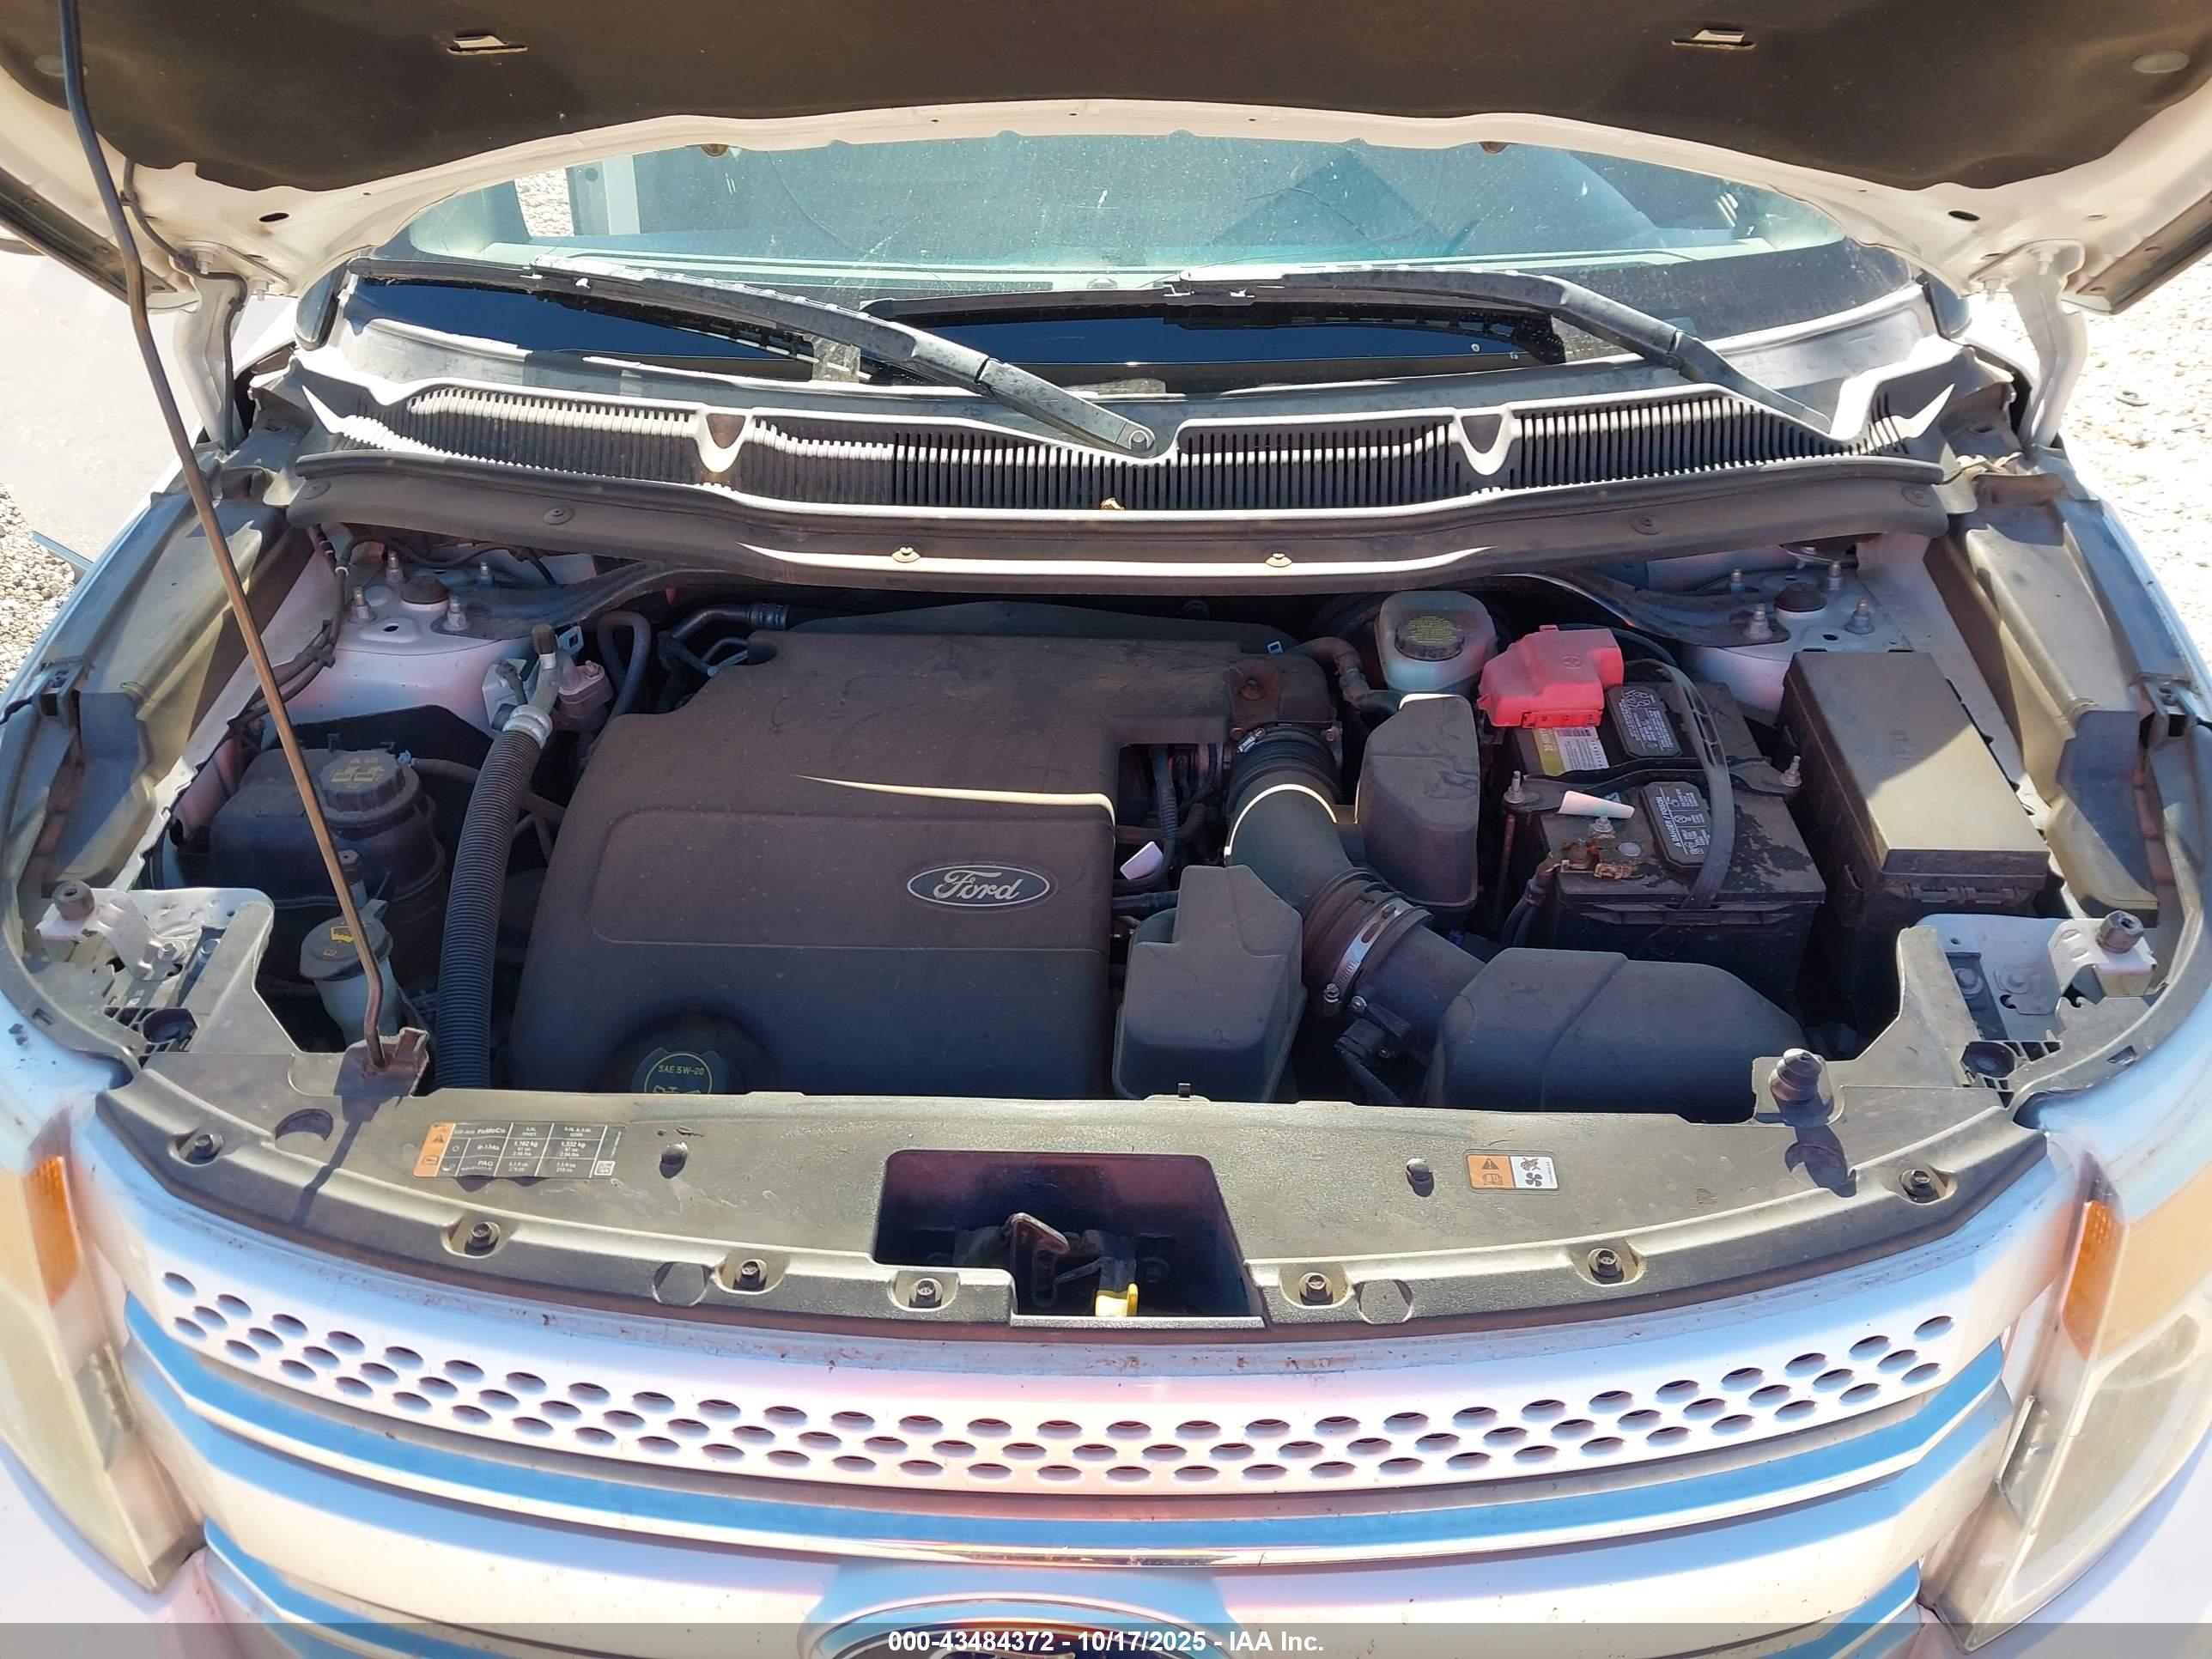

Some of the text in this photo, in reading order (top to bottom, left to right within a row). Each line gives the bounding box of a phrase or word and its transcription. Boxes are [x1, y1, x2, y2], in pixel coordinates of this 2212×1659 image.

[933, 870, 1024, 899] Ford
[658, 1065, 705, 1075] SAE 5W-20
